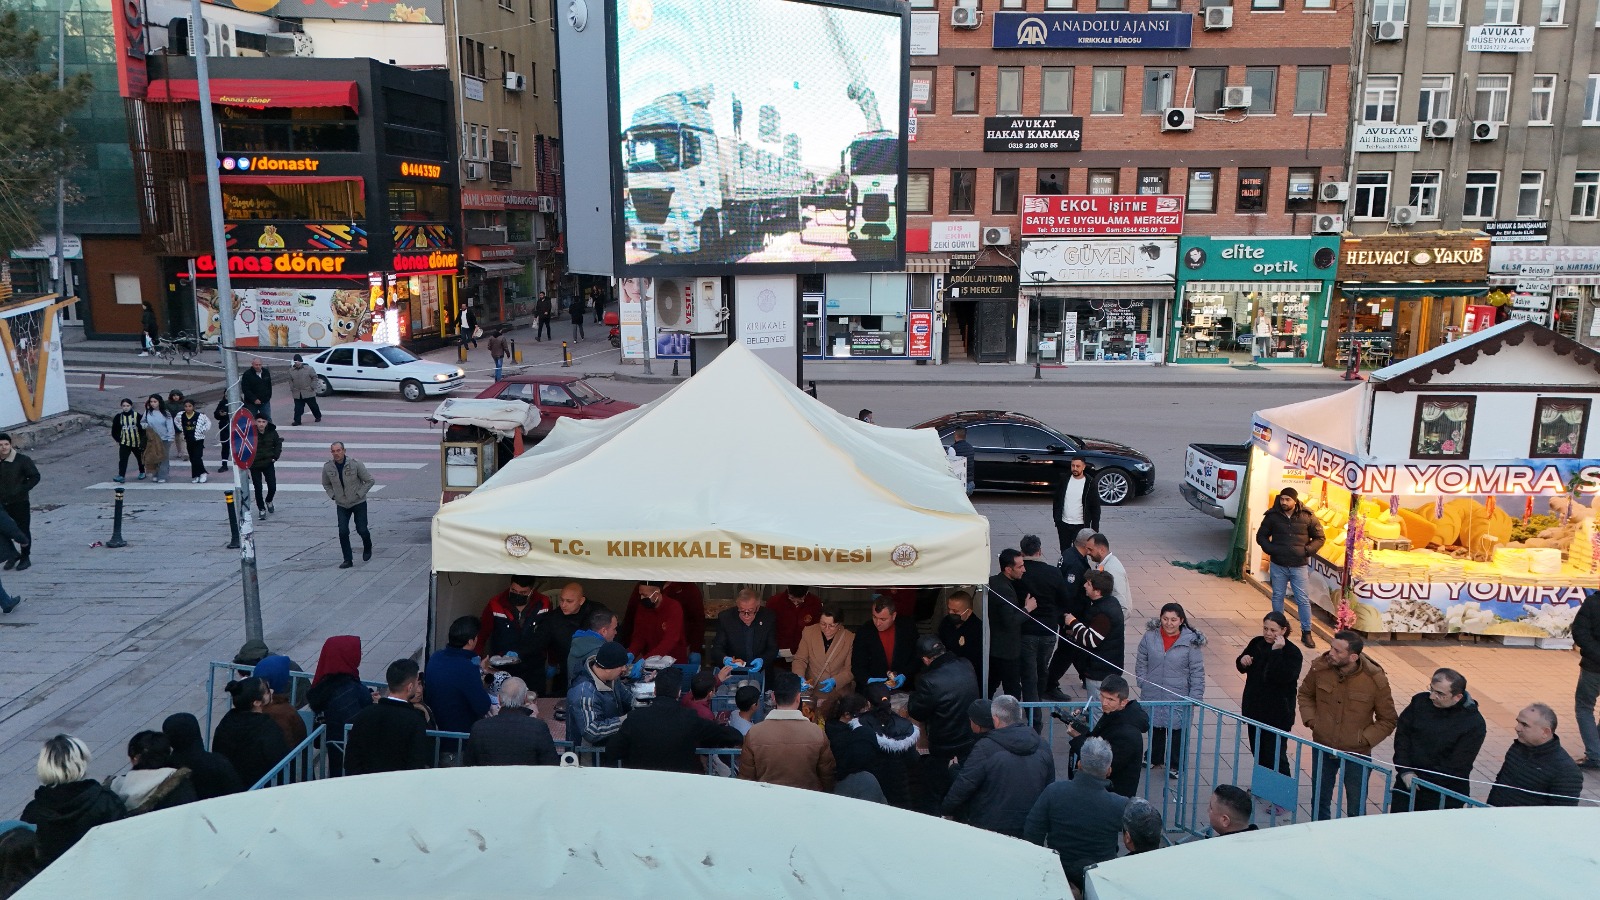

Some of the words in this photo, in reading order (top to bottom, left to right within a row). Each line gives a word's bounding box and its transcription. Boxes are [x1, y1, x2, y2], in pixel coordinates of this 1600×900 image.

[1052, 20, 1119, 32] ANADOLU
[1124, 20, 1170, 34] AJANSI
[1481, 28, 1524, 36] AVUKAT
[1114, 35, 1142, 44] BÜROSU
[1472, 36, 1507, 44] HÜSEYİN
[1011, 119, 1056, 128] AVUKAT
[986, 131, 1025, 139] HAKAN
[1027, 130, 1080, 141] KARAKAŞ
[1397, 136, 1418, 144] AYAŞ
[250, 156, 319, 171] /donastr
[409, 163, 441, 178] 4443367
[1143, 176, 1161, 184] İŞİTM
[1060, 199, 1098, 212] EKOL
[1109, 198, 1147, 213] İŞİTME
[1026, 216, 1055, 226] SATIŞ
[1058, 216, 1070, 224] VE
[1074, 216, 1130, 225] UYGULAMA
[1134, 214, 1179, 225] MERKEZİ
[934, 240, 950, 248] ZEKİ
[951, 240, 976, 248] GÜRYIL
[1064, 244, 1135, 265] GÜVEN
[1221, 244, 1265, 259] elite
[1346, 250, 1409, 265] HELVACI
[1434, 247, 1483, 264] YAKUB
[274, 253, 345, 272] döner
[393, 254, 429, 271] donas
[428, 251, 459, 269] döner
[1253, 261, 1298, 276] optik
[1528, 267, 1550, 275] Belediye
[950, 275, 987, 283] ABDULLAH
[988, 275, 1013, 283] TURAN
[961, 287, 968, 295] İŞ
[970, 286, 1002, 294] MERKEZİ
[1271, 293, 1297, 303] elite
[1515, 298, 1531, 306] Adliye
[1283, 302, 1307, 313] optik
[746, 320, 787, 331] KIRIKKALE
[746, 333, 787, 345] BELEDİYESİ
[1286, 434, 1396, 493] TRABZON
[1405, 464, 1566, 493] YOMRA
[1186, 470, 1217, 494] RANGER
[550, 538, 591, 555] T.C.
[607, 541, 732, 558] KIRIKKALE
[740, 542, 872, 562] BELEDİYESİ
